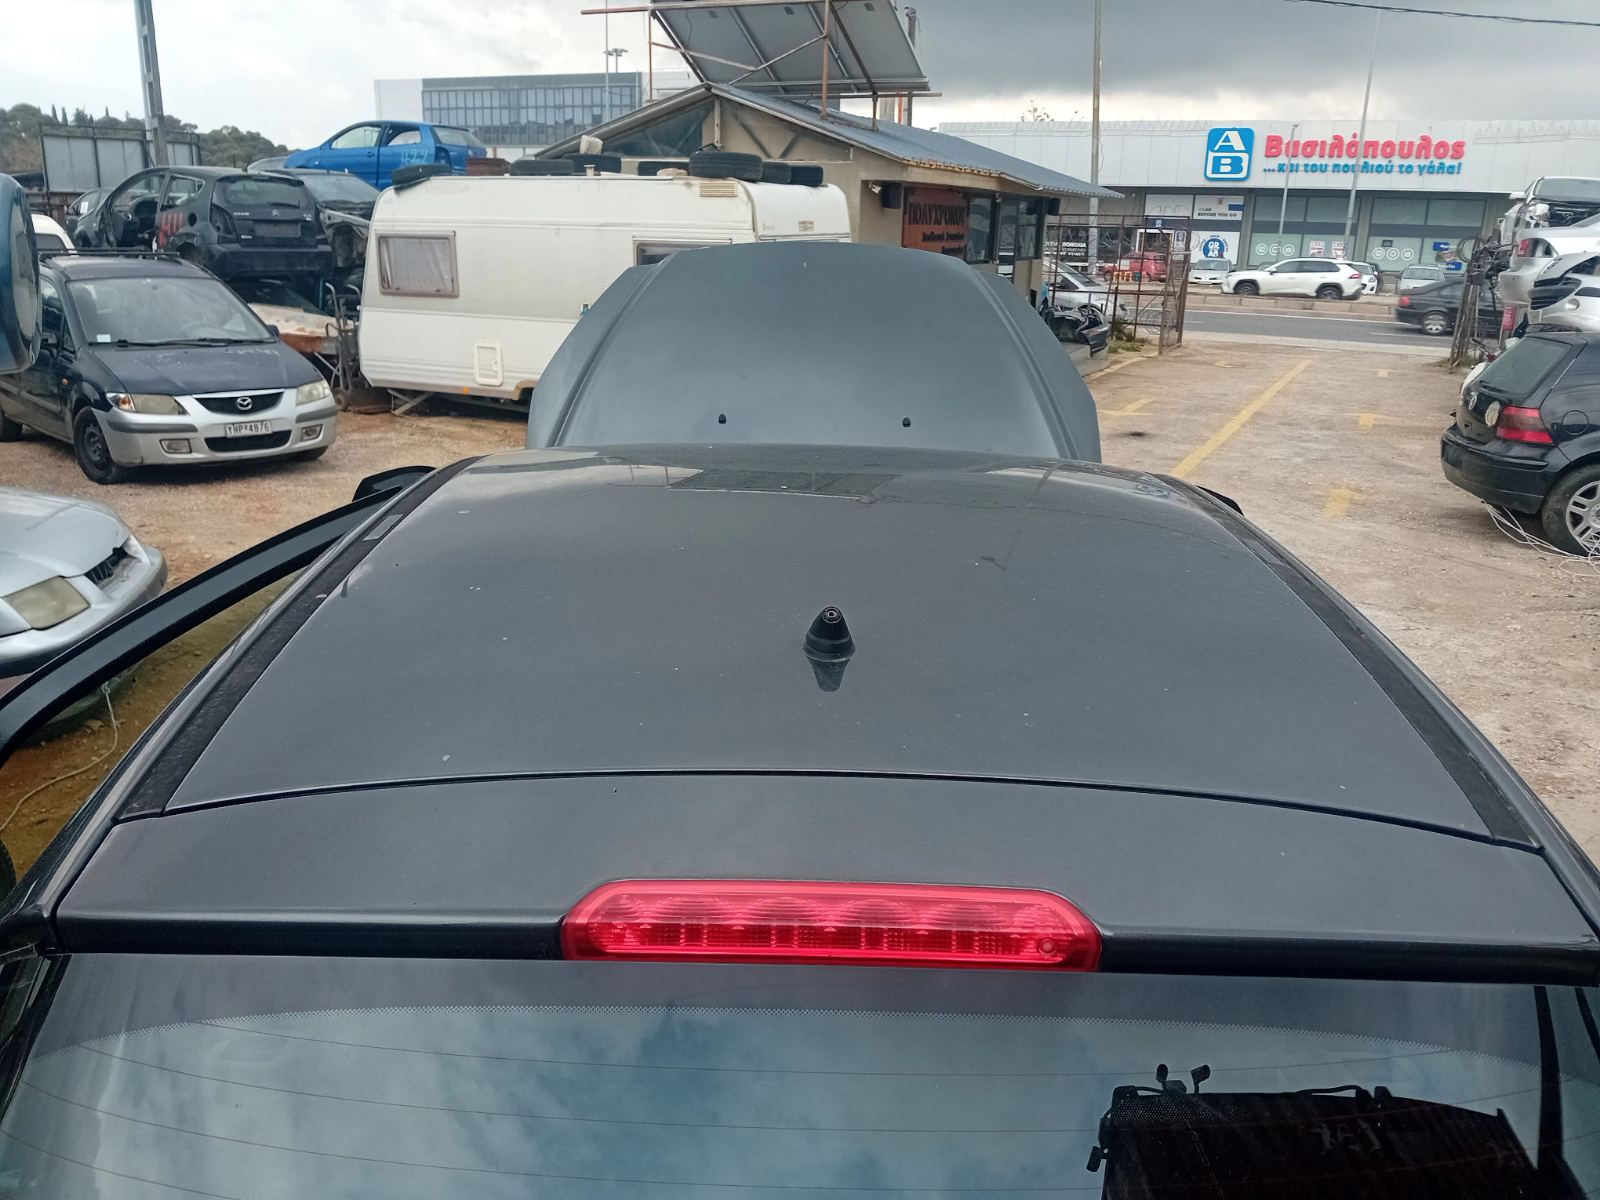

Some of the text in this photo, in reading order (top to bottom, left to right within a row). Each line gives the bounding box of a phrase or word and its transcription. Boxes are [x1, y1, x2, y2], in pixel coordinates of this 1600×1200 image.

[1264, 132, 1466, 159] Βασιλόπουλος
[1303, 163, 1329, 173] του
[1398, 163, 1415, 174] το
[1417, 160, 1463, 176] γάλα!
